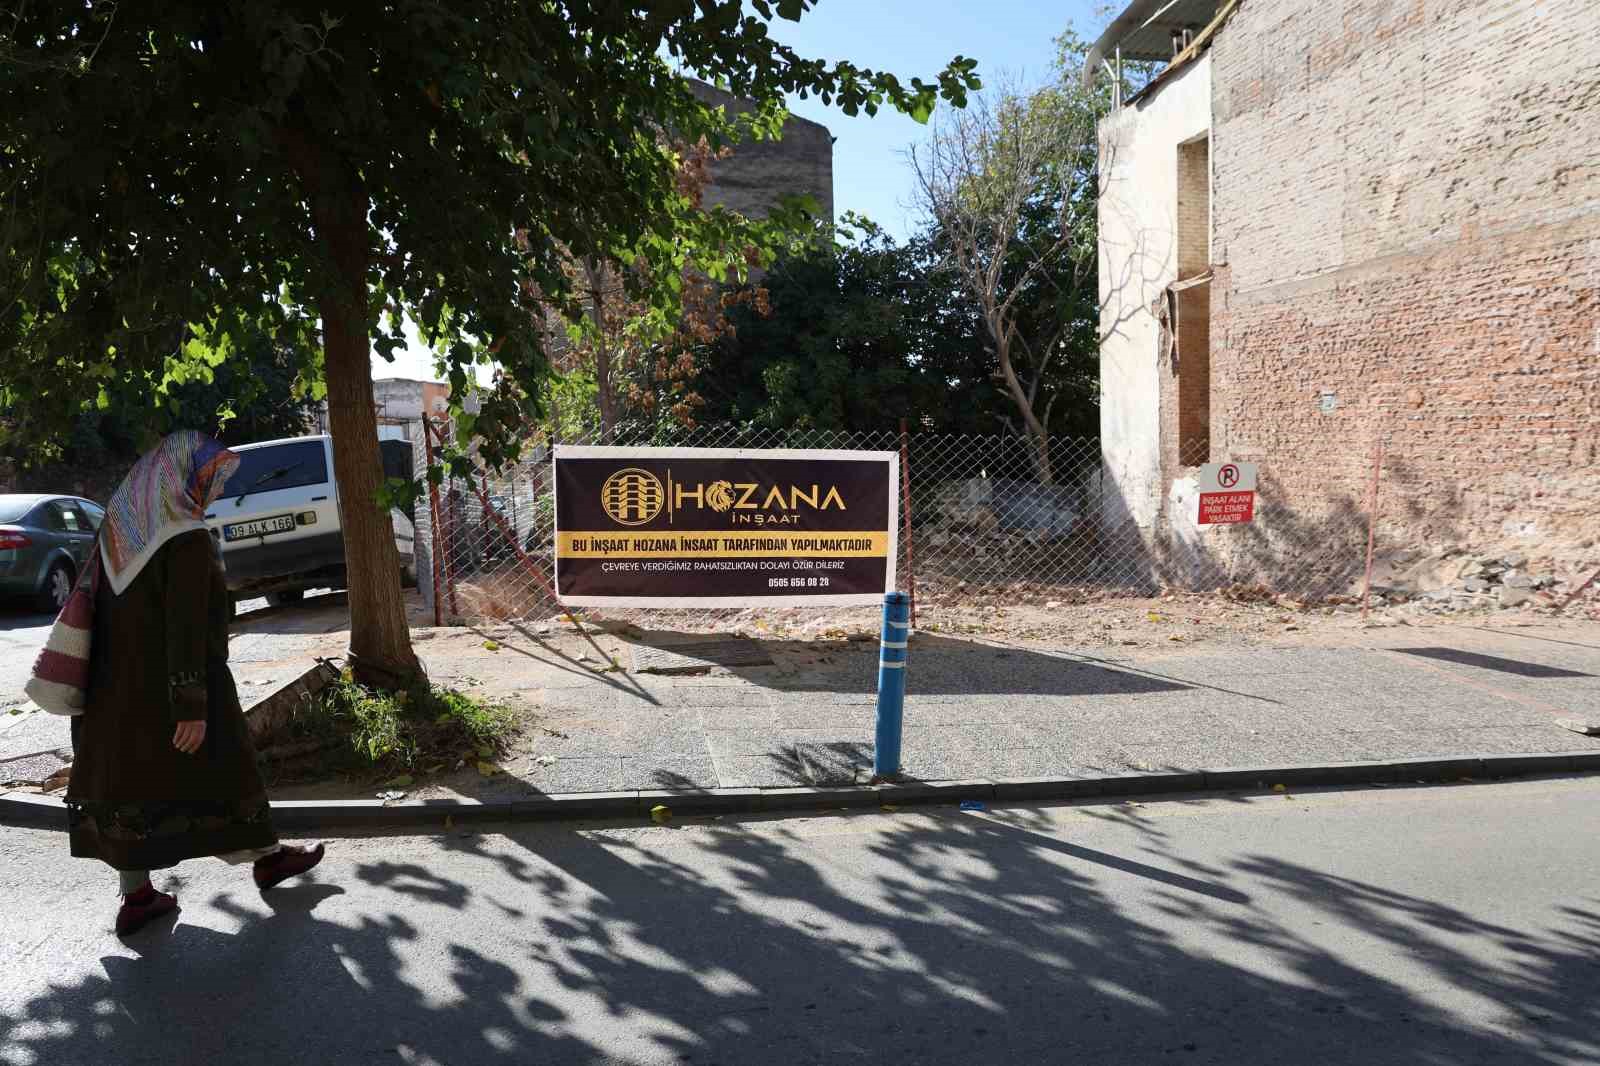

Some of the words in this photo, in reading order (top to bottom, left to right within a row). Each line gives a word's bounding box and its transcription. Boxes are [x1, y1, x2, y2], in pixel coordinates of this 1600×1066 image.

[675, 480, 847, 512] HOZANA
[230, 525, 245, 537] 09
[272, 518, 292, 530] 166
[732, 512, 801, 526] İNŞAAT
[572, 539, 587, 552] BU
[590, 536, 630, 554] İNŞAAT
[633, 539, 677, 552] HOZANA
[722, 538, 788, 551] TARAFINDAN
[790, 538, 873, 551] YAPILMAKTADIR
[601, 562, 640, 573] ÇEVREYE
[641, 560, 692, 571] VERDİĞİMİZ
[693, 561, 758, 570] RAHATSIZLIKTAN
[760, 561, 790, 570] DOLAYI
[792, 559, 814, 570] ÖZÜR
[815, 560, 845, 570] DİLERİZ
